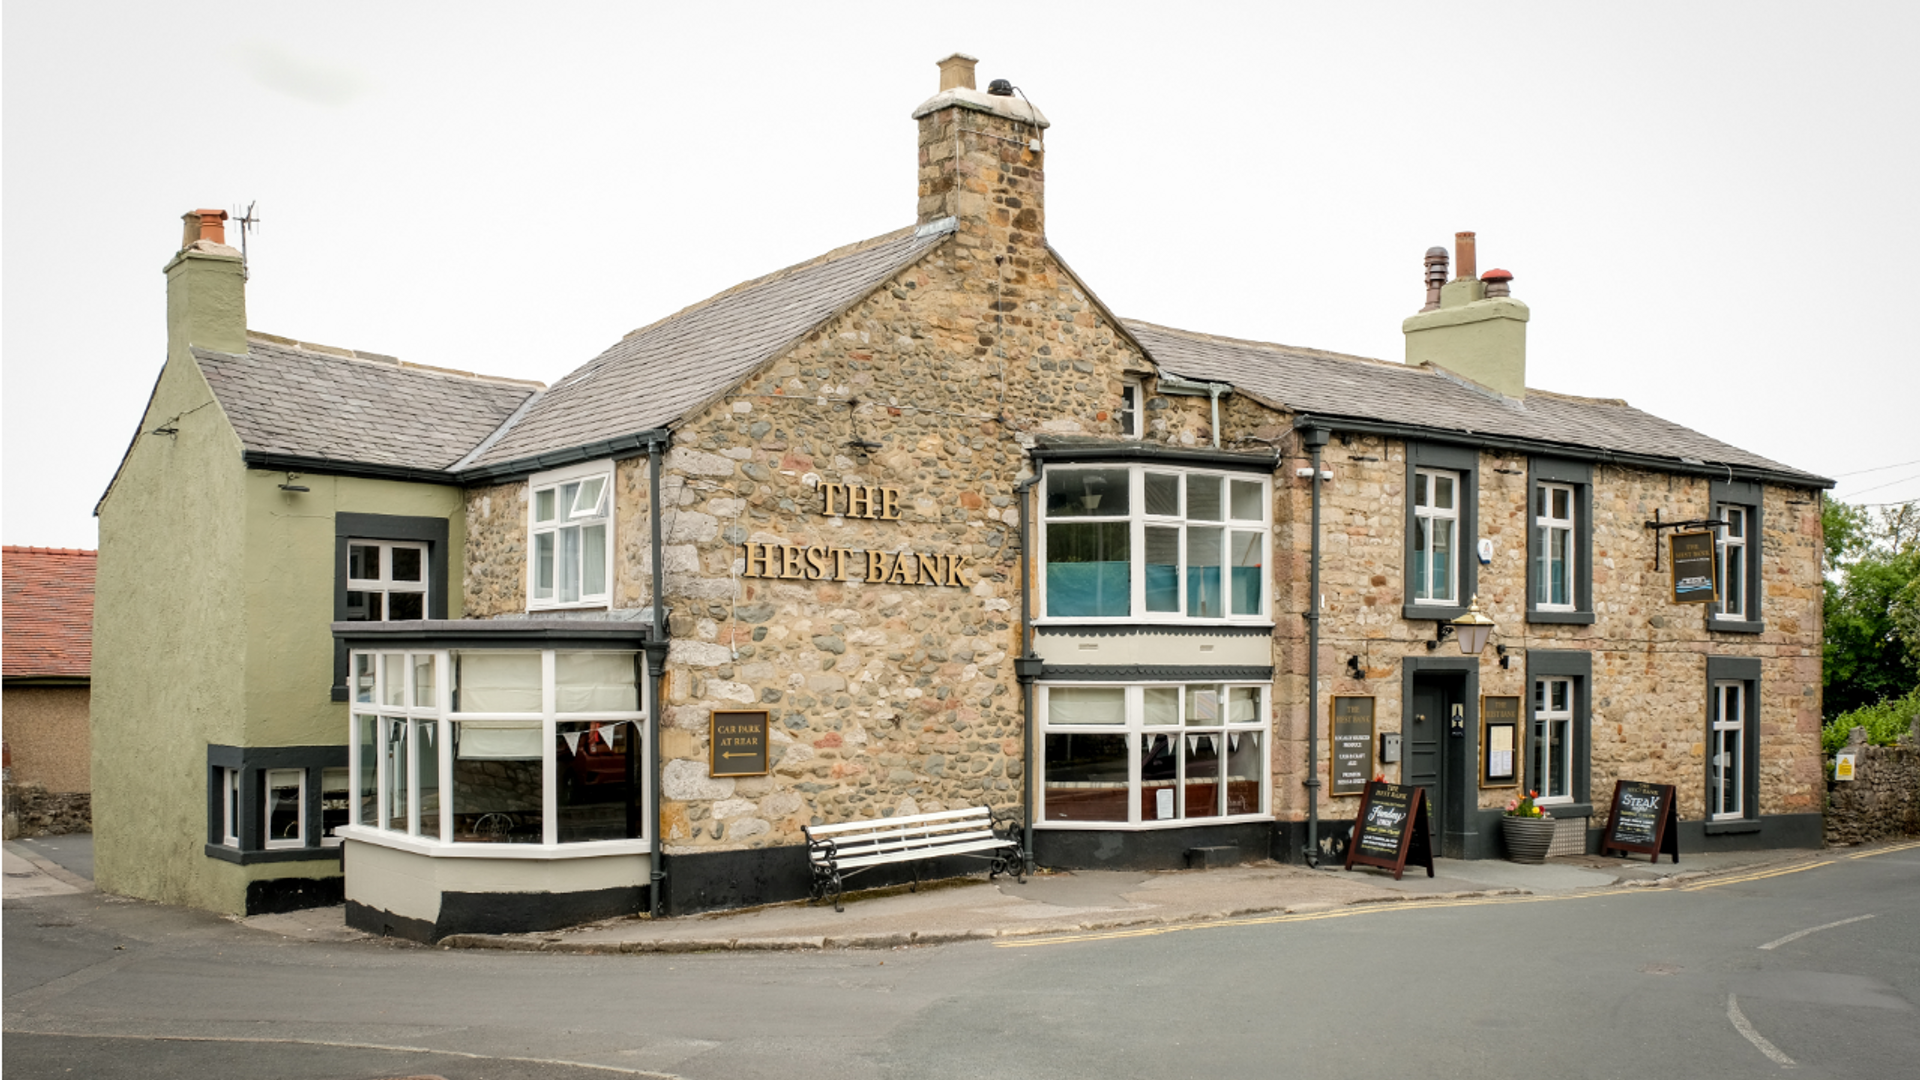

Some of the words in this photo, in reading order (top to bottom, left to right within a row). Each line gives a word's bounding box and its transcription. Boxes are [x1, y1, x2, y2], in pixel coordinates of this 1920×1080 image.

[816, 481, 902, 520] THE
[743, 542, 854, 582] HEST
[865, 549, 972, 587] BANK
[717, 725, 736, 734] CAR
[738, 725, 761, 733] PARK
[720, 737, 732, 746] AT
[734, 737, 758, 745] REAR
[1367, 805, 1407, 824] Sunday
